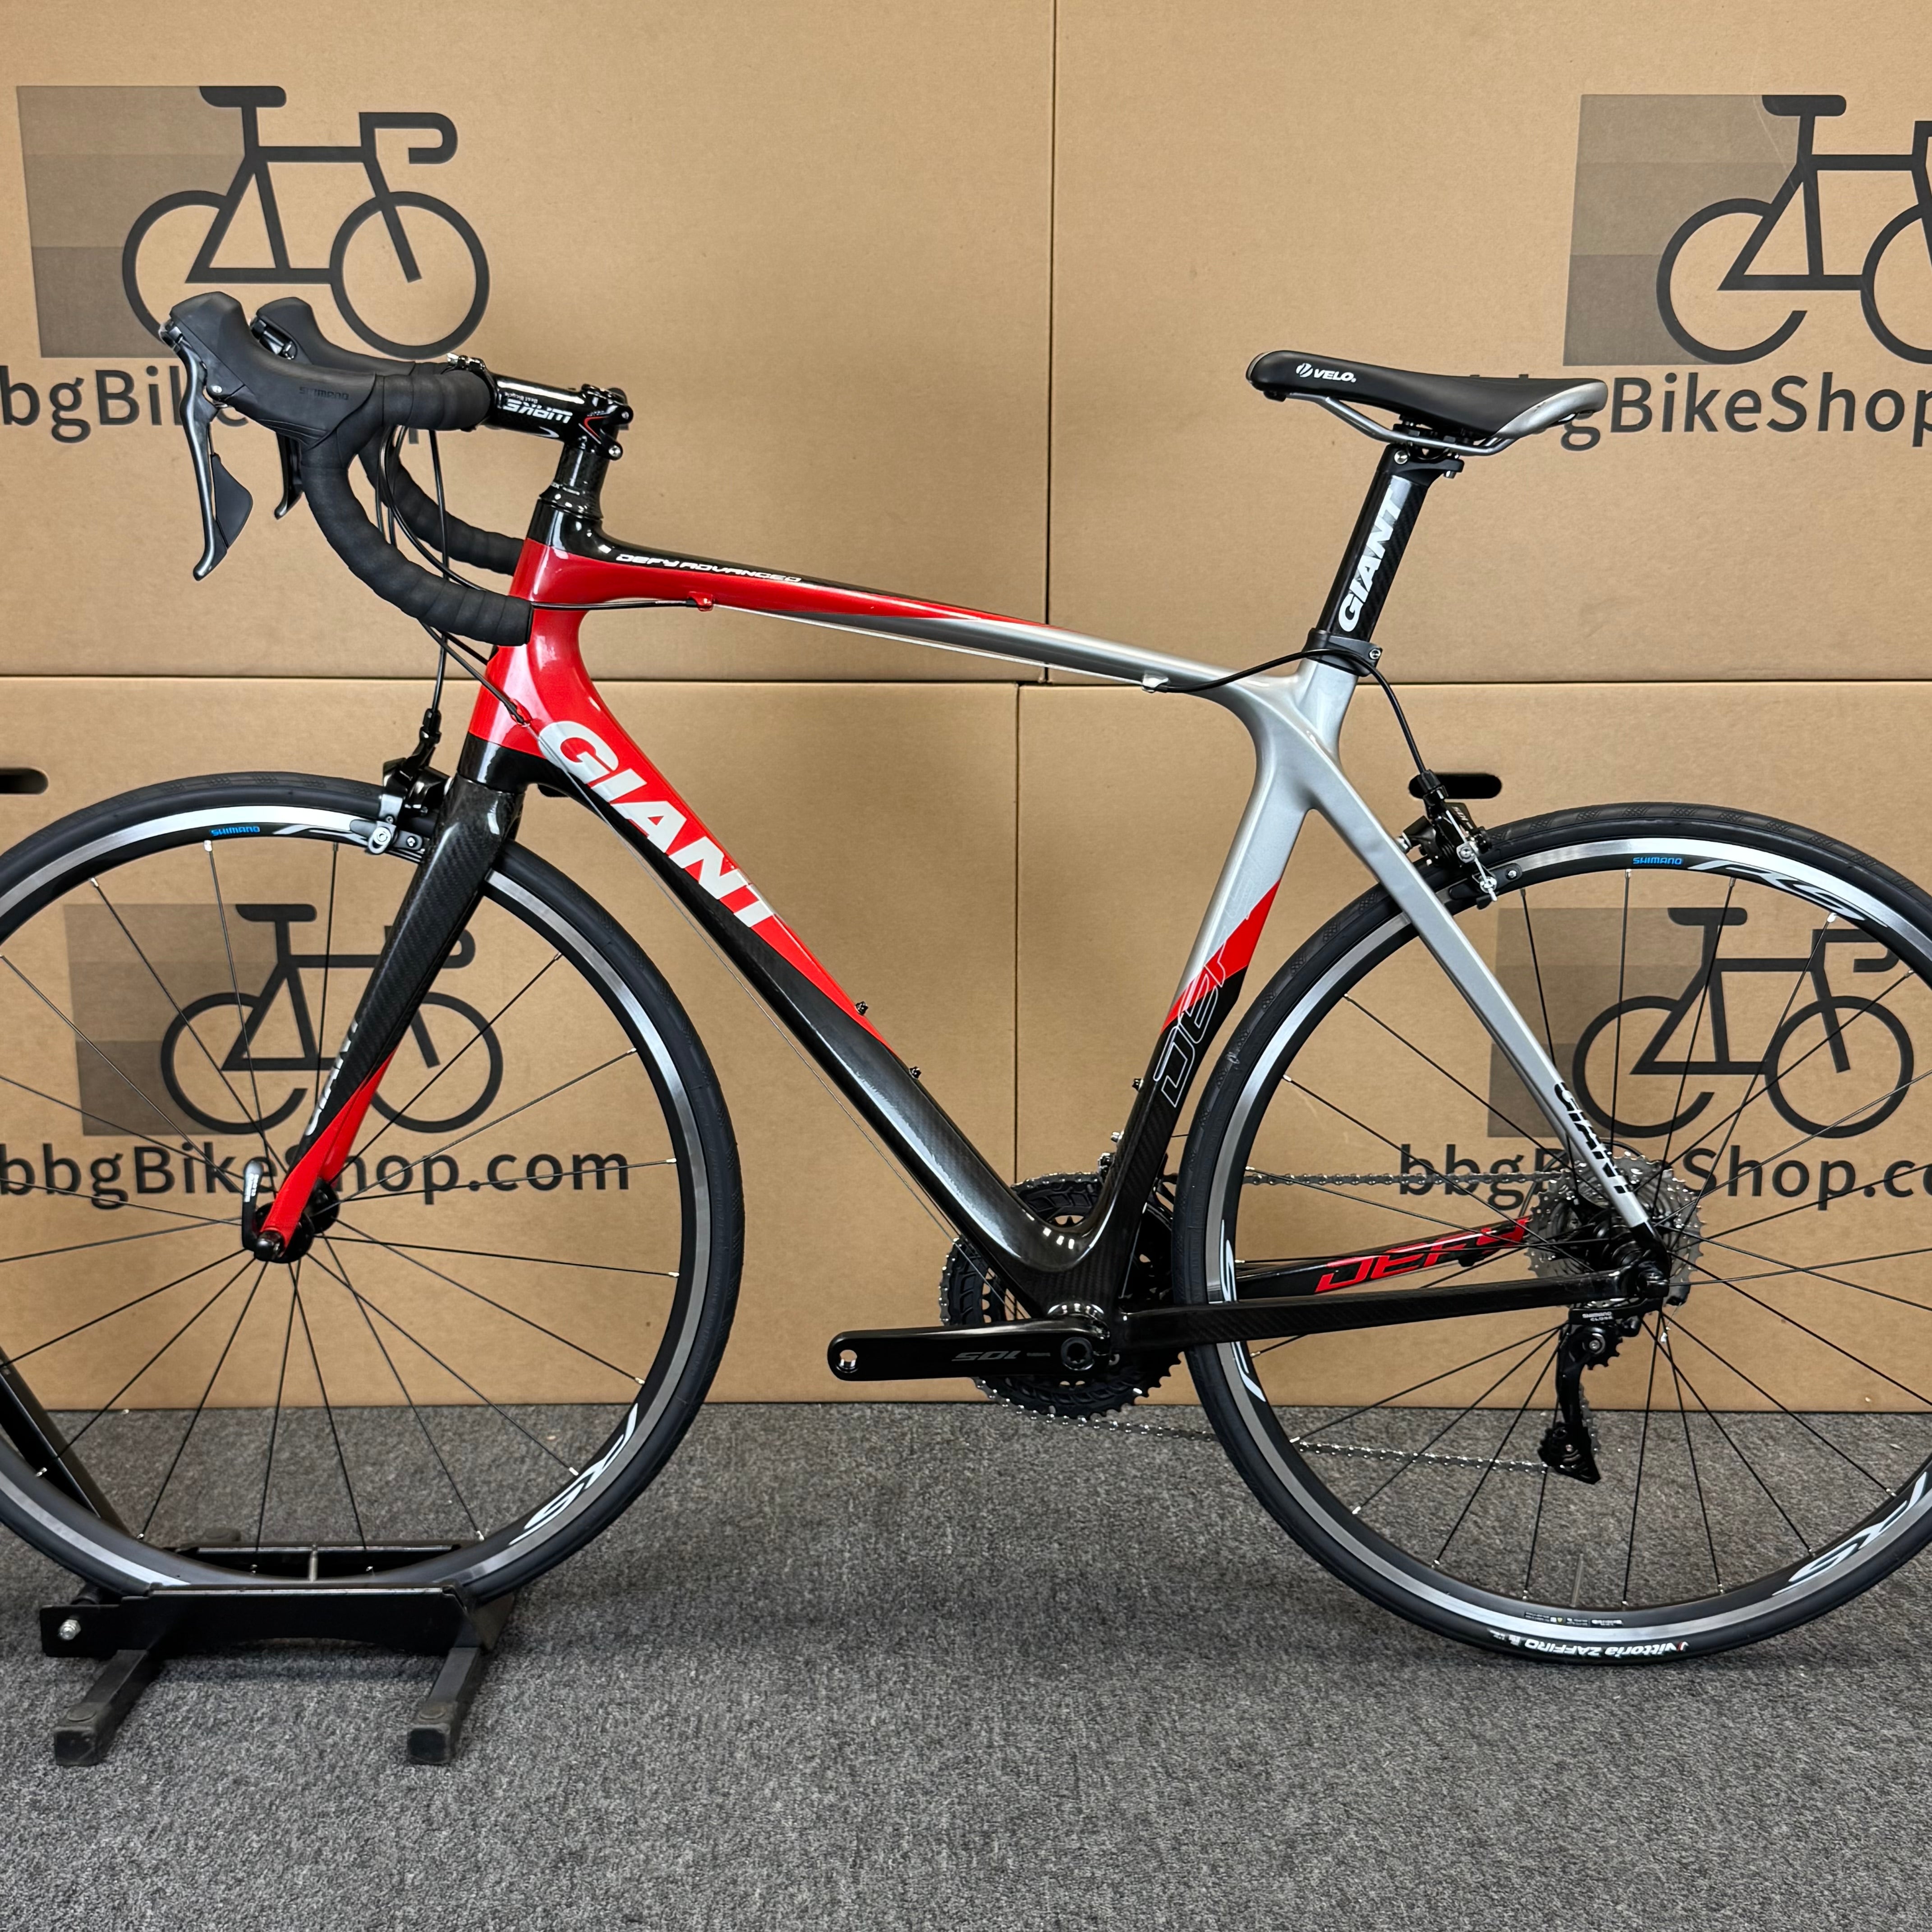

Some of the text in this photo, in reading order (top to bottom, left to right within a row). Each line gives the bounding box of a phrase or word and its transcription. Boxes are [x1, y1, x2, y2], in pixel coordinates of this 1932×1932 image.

[616, 554, 802, 582] DEFY ADVANCED
[1338, 487, 1405, 632] GIANT
[210, 826, 260, 836] SHIMANO
[538, 721, 777, 928] GIANT
[1632, 856, 1684, 865] SHIMANO
[1524, 1638, 1602, 1656] ZAFFIRO
